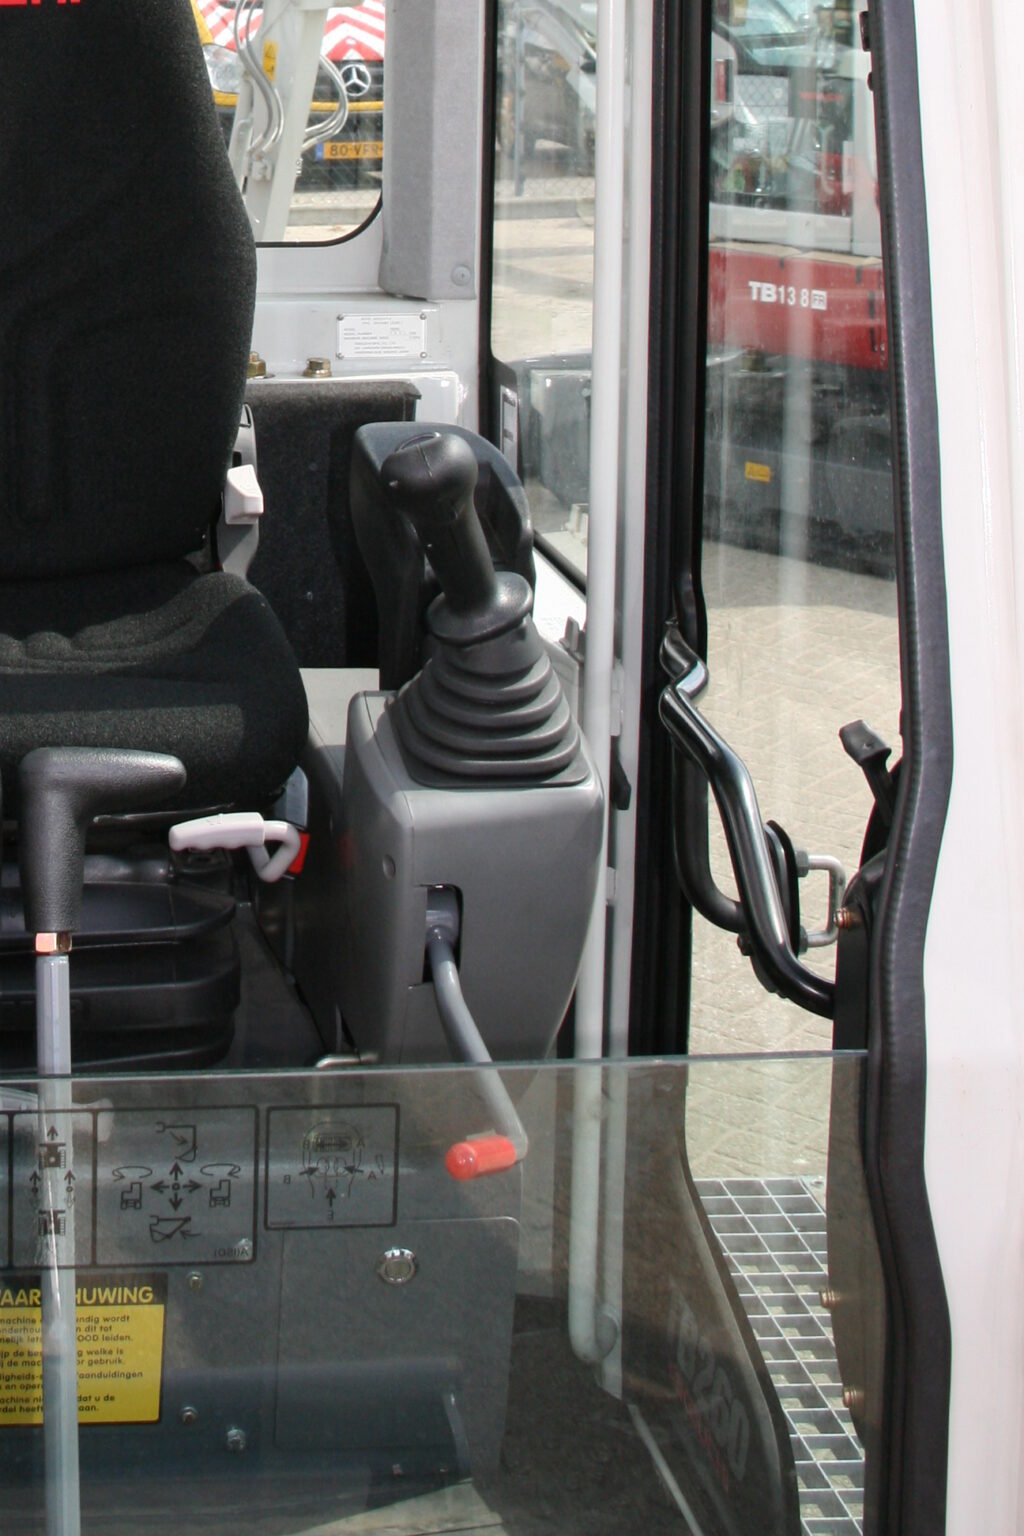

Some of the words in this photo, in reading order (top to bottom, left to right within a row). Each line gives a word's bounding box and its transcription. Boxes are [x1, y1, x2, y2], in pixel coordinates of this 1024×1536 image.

[103, 1314, 130, 1323] wordt
[85, 1325, 96, 1333] dit
[100, 1324, 112, 1332] tot
[13, 1349, 25, 1357] de
[87, 1347, 114, 1356] welke
[116, 1347, 124, 1355] is
[7, 1359, 18, 1368] de
[104, 1393, 115, 1402] de
